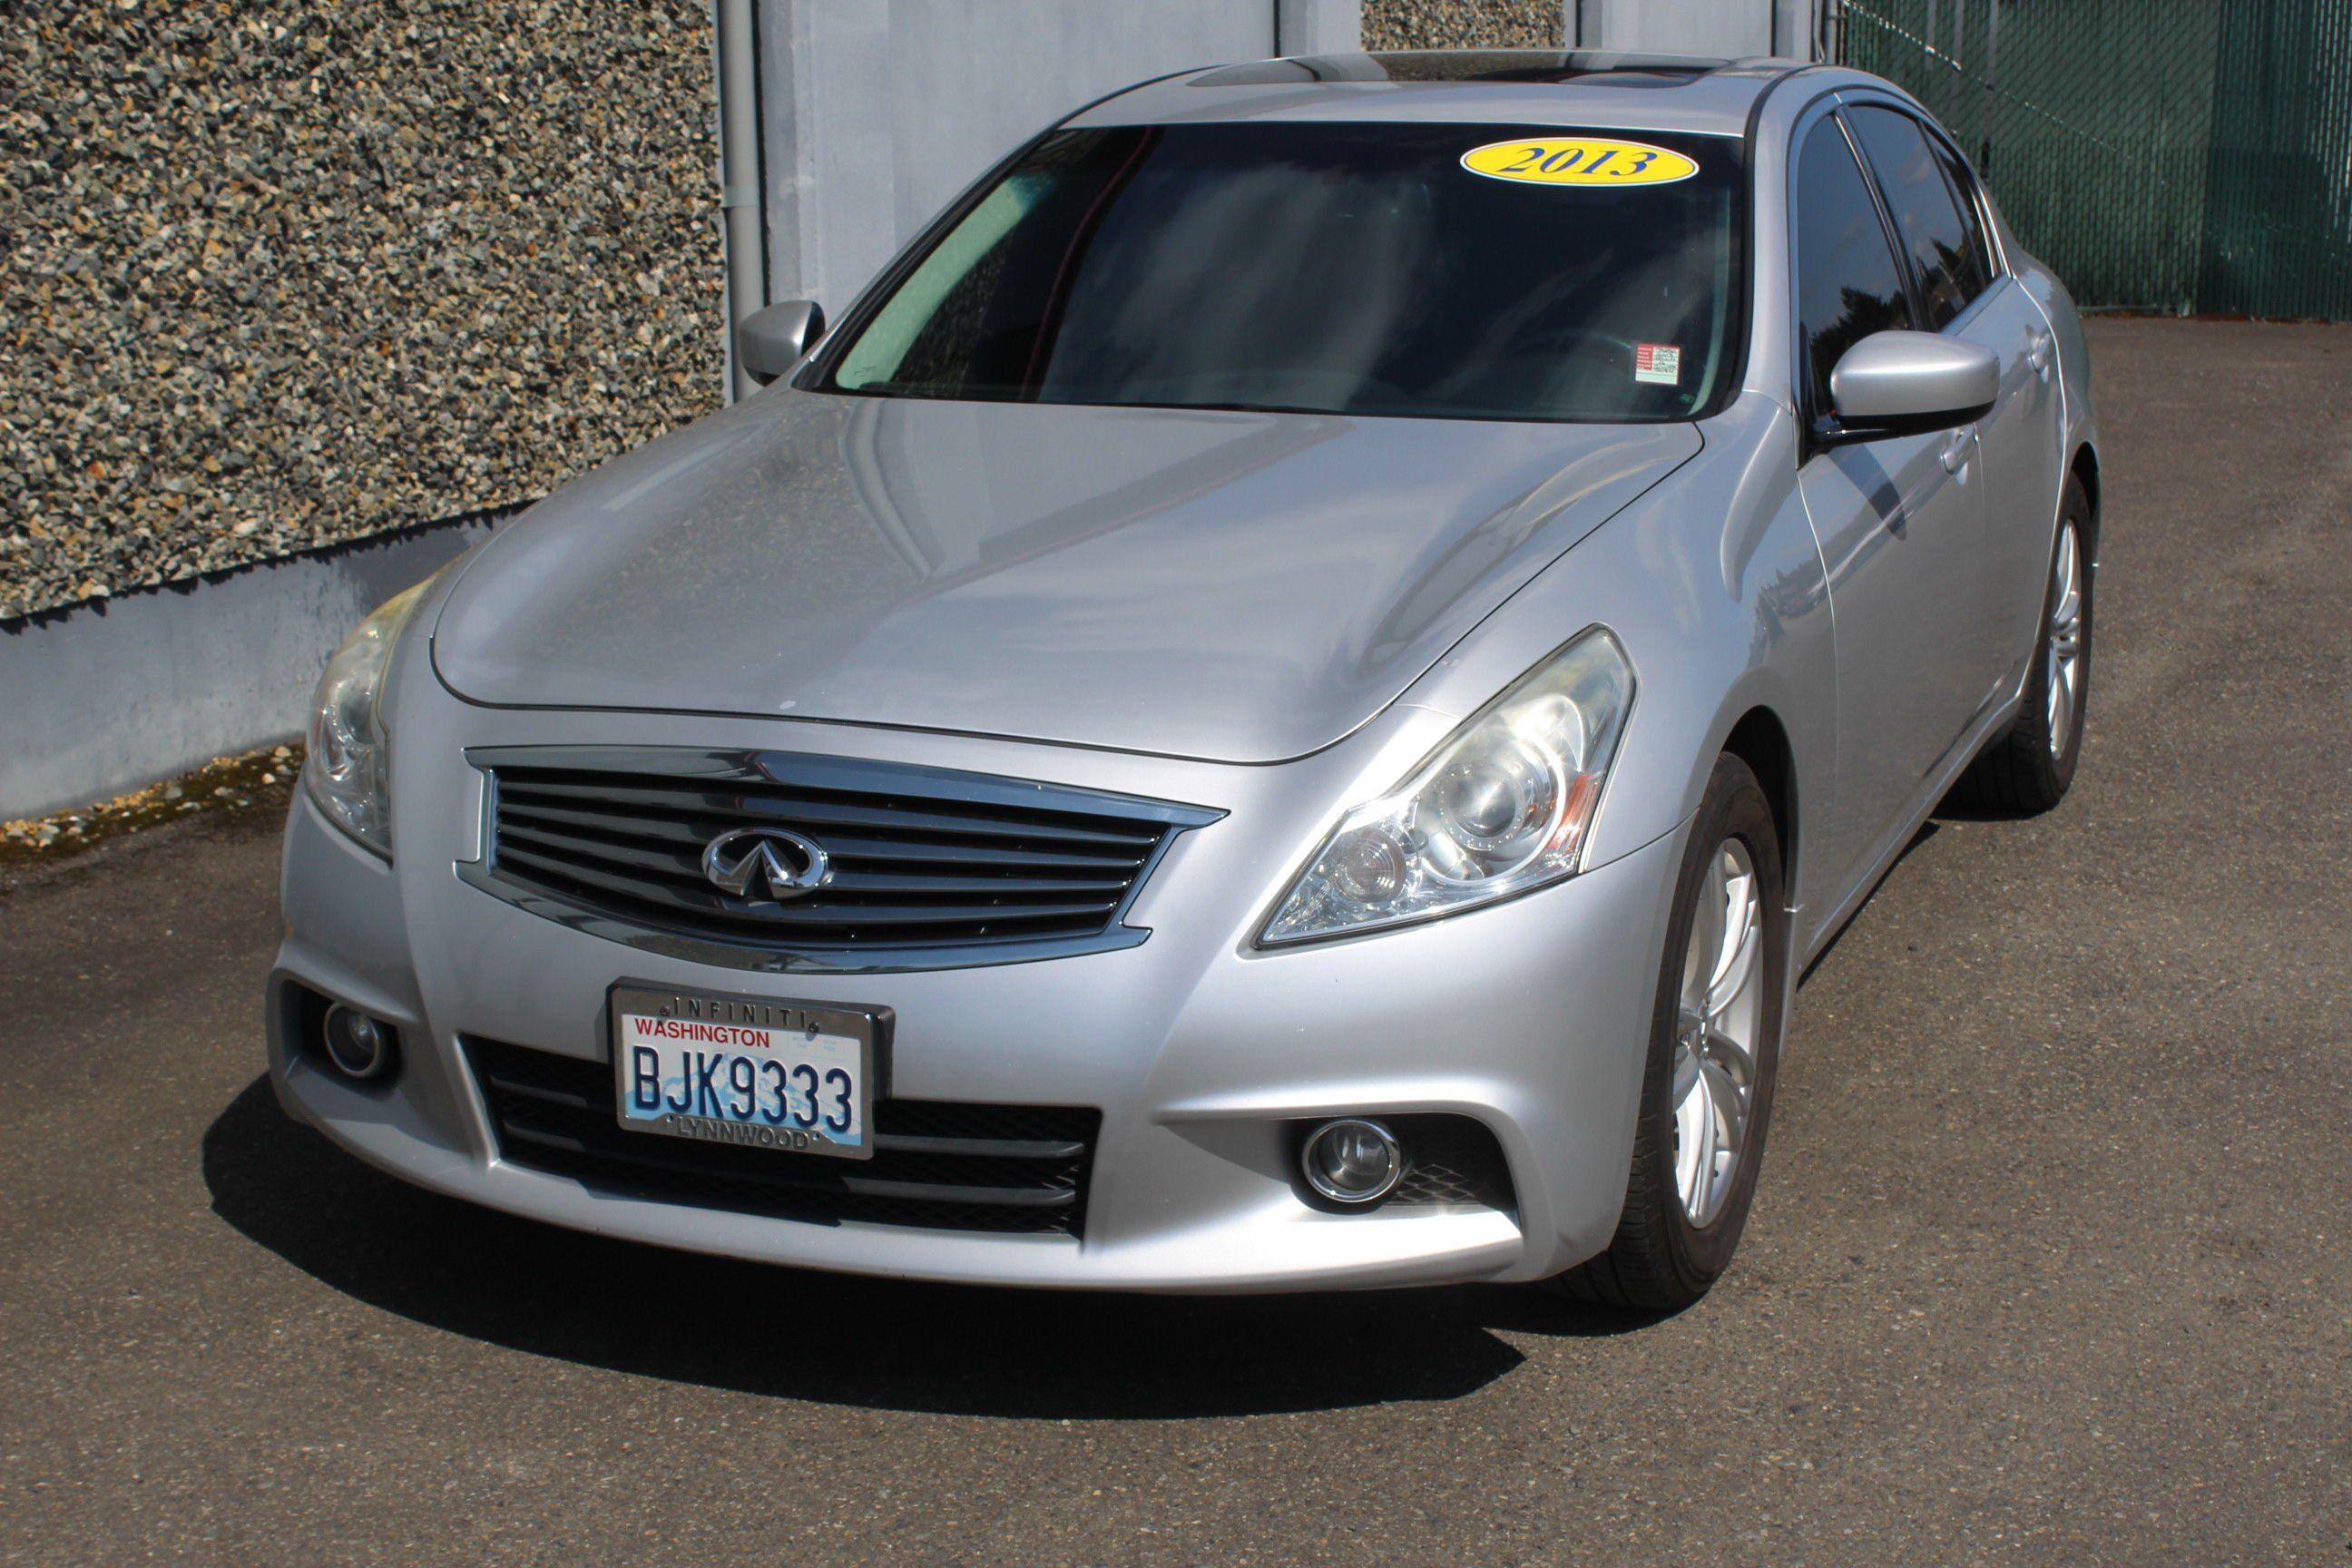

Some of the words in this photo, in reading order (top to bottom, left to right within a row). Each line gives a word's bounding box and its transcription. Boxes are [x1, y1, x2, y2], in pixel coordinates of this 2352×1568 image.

[1497, 147, 1658, 176] 2013
[673, 997, 807, 1027] INFINITI
[634, 1018, 769, 1048] WASHINGTON
[633, 1045, 852, 1133] BJK9333
[677, 1117, 808, 1150] LYNNWOOD
